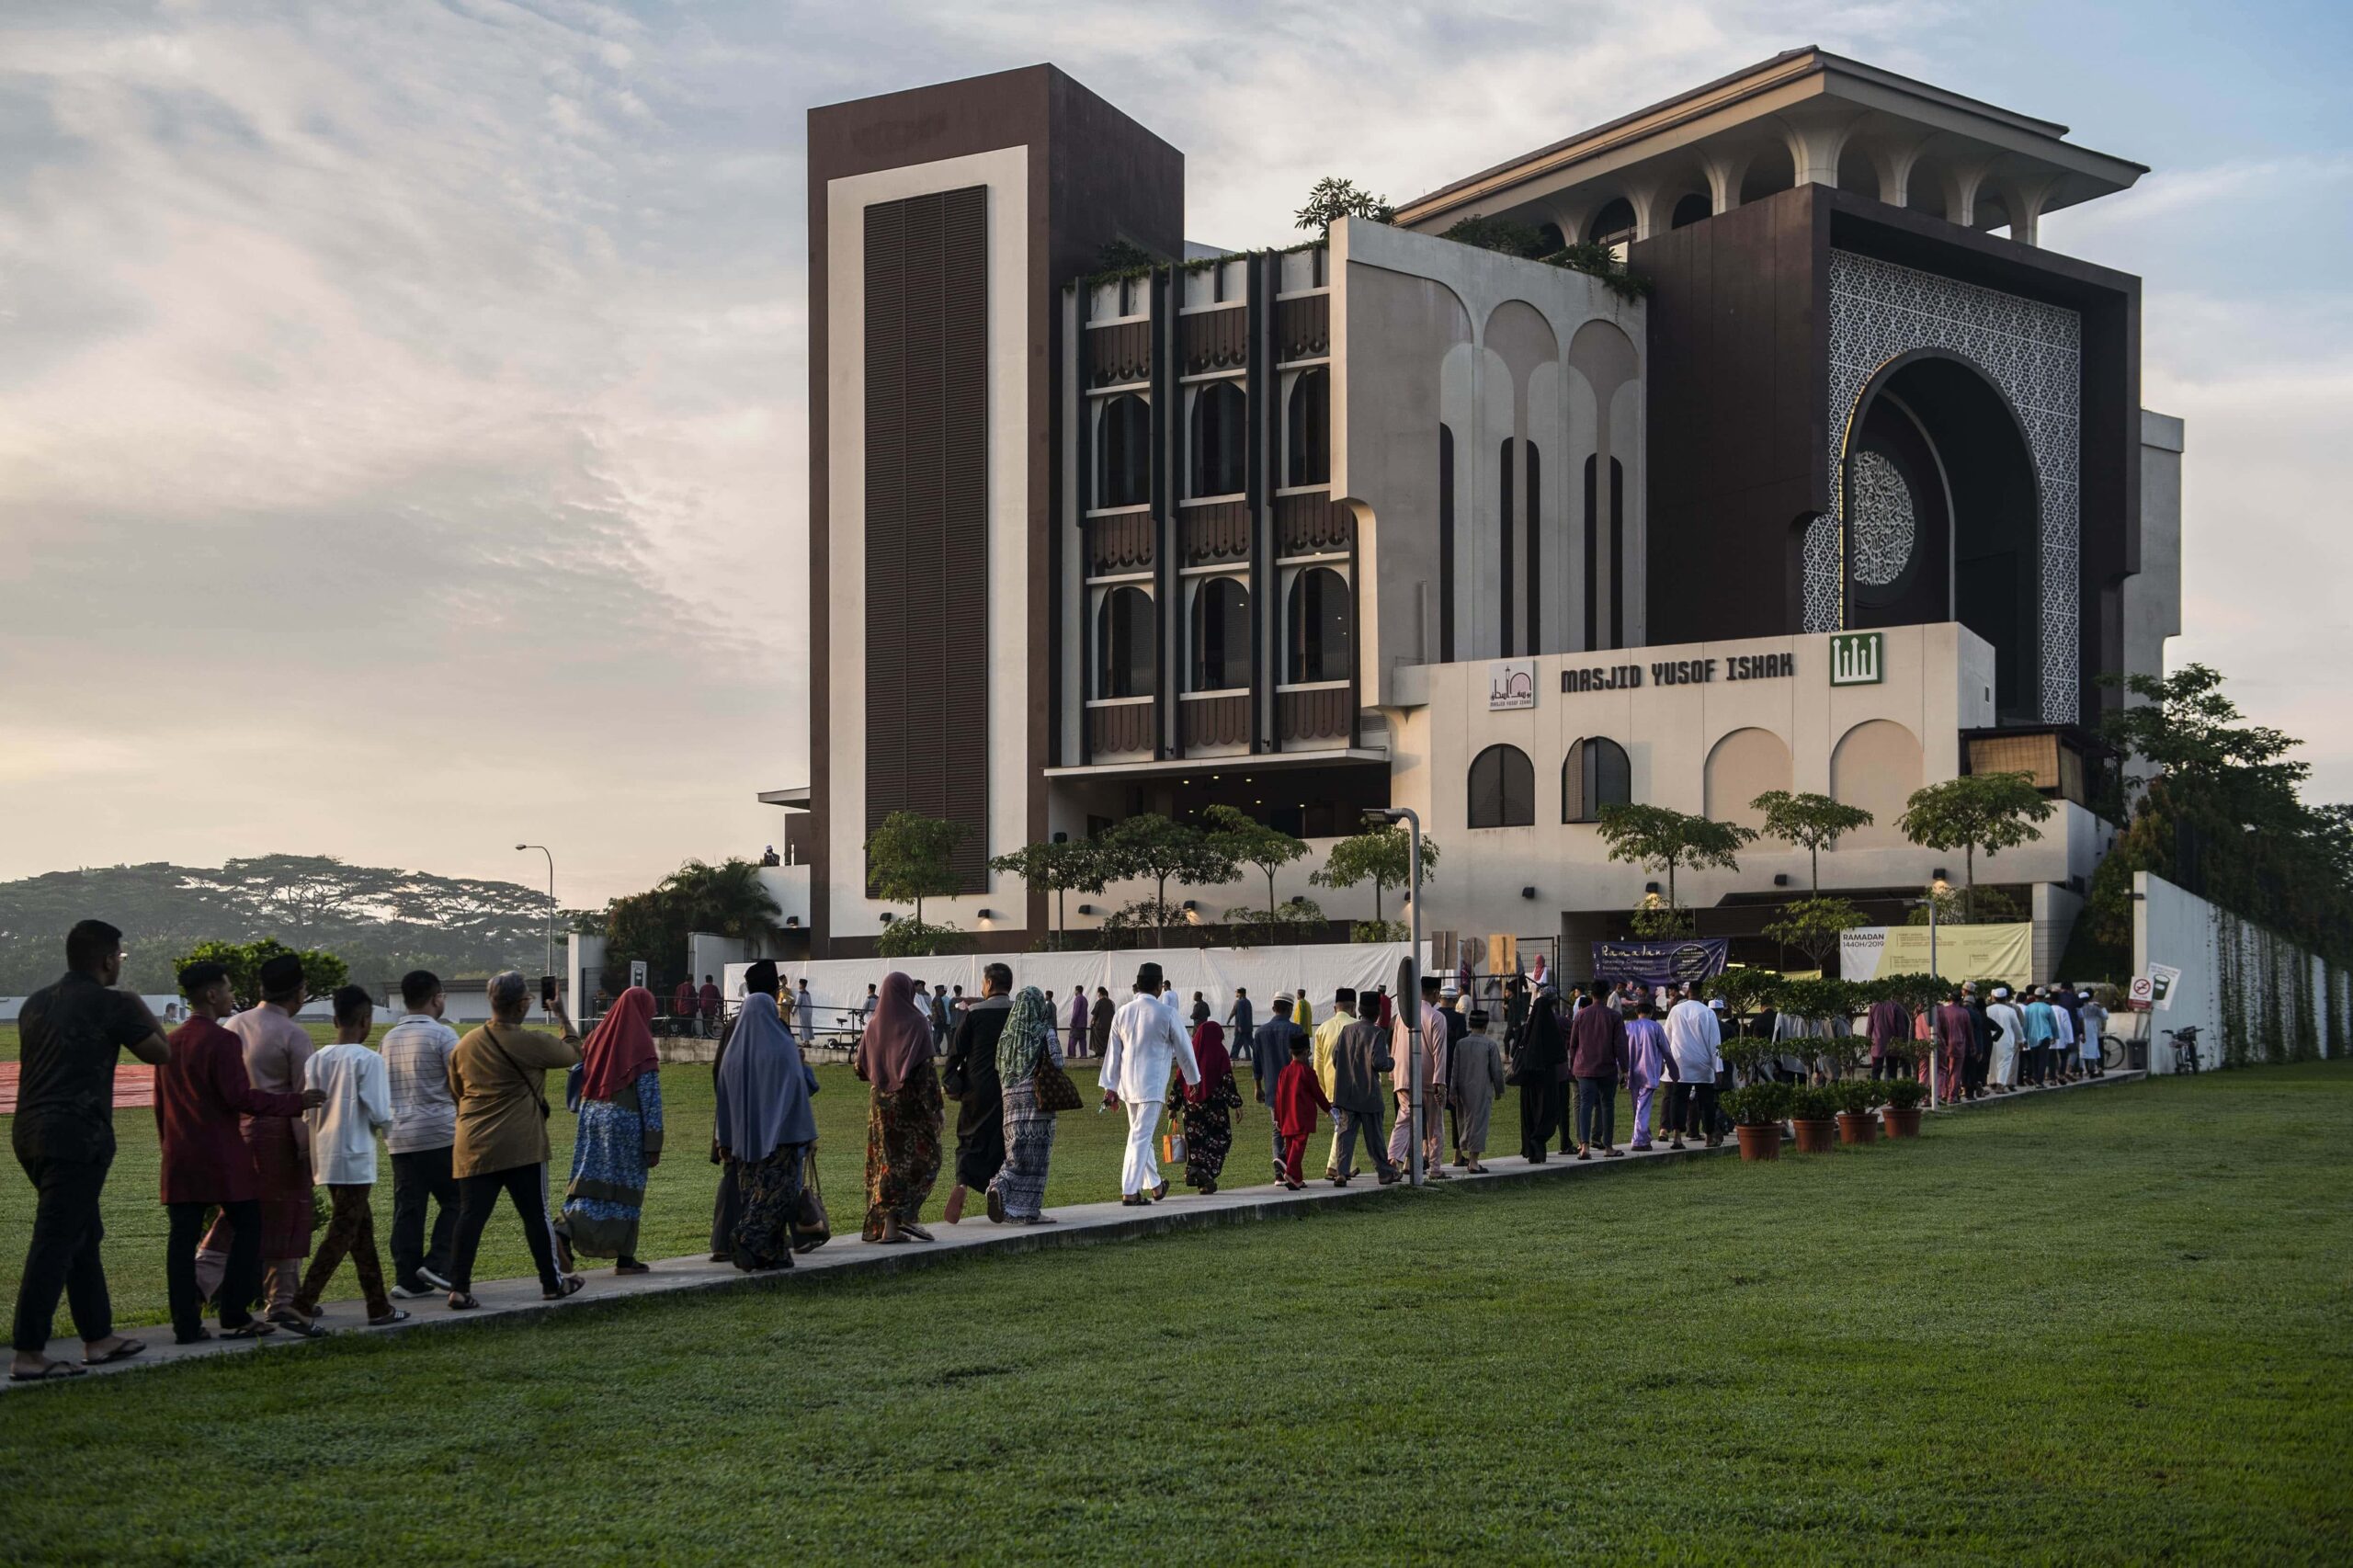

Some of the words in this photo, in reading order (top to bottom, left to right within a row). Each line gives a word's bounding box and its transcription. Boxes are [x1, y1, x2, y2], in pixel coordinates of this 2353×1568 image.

[1561, 665, 1642, 694] MASJID
[1652, 659, 1716, 687] YUSOF
[1726, 653, 1793, 682] ISHAK
[1843, 933, 1884, 941] RAMADAN
